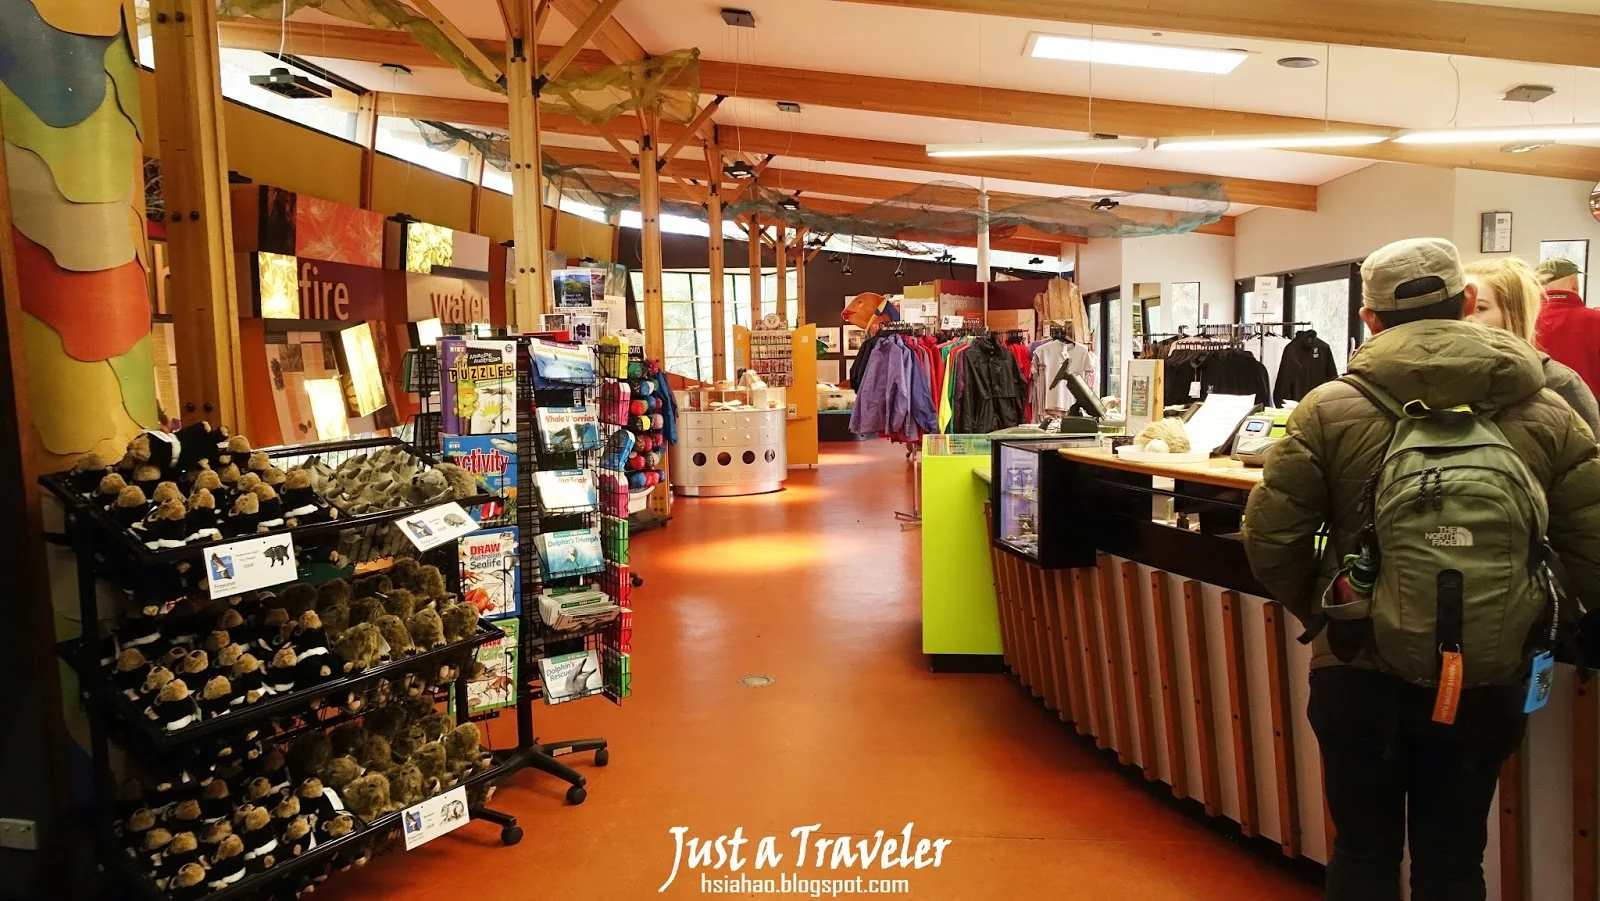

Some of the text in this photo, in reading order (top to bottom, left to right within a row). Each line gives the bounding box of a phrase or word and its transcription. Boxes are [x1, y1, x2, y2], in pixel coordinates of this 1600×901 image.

[299, 262, 350, 321] fire
[431, 289, 489, 323] water
[451, 364, 513, 382] PUZZLES
[546, 414, 565, 423] Whale
[548, 535, 598, 547] Dolphin's Triumph
[470, 542, 501, 556] DRAW
[470, 552, 502, 561] Australian
[470, 559, 502, 570] Sealife
[546, 661, 575, 677] Dolphin's
[550, 670, 572, 681] Rescue
